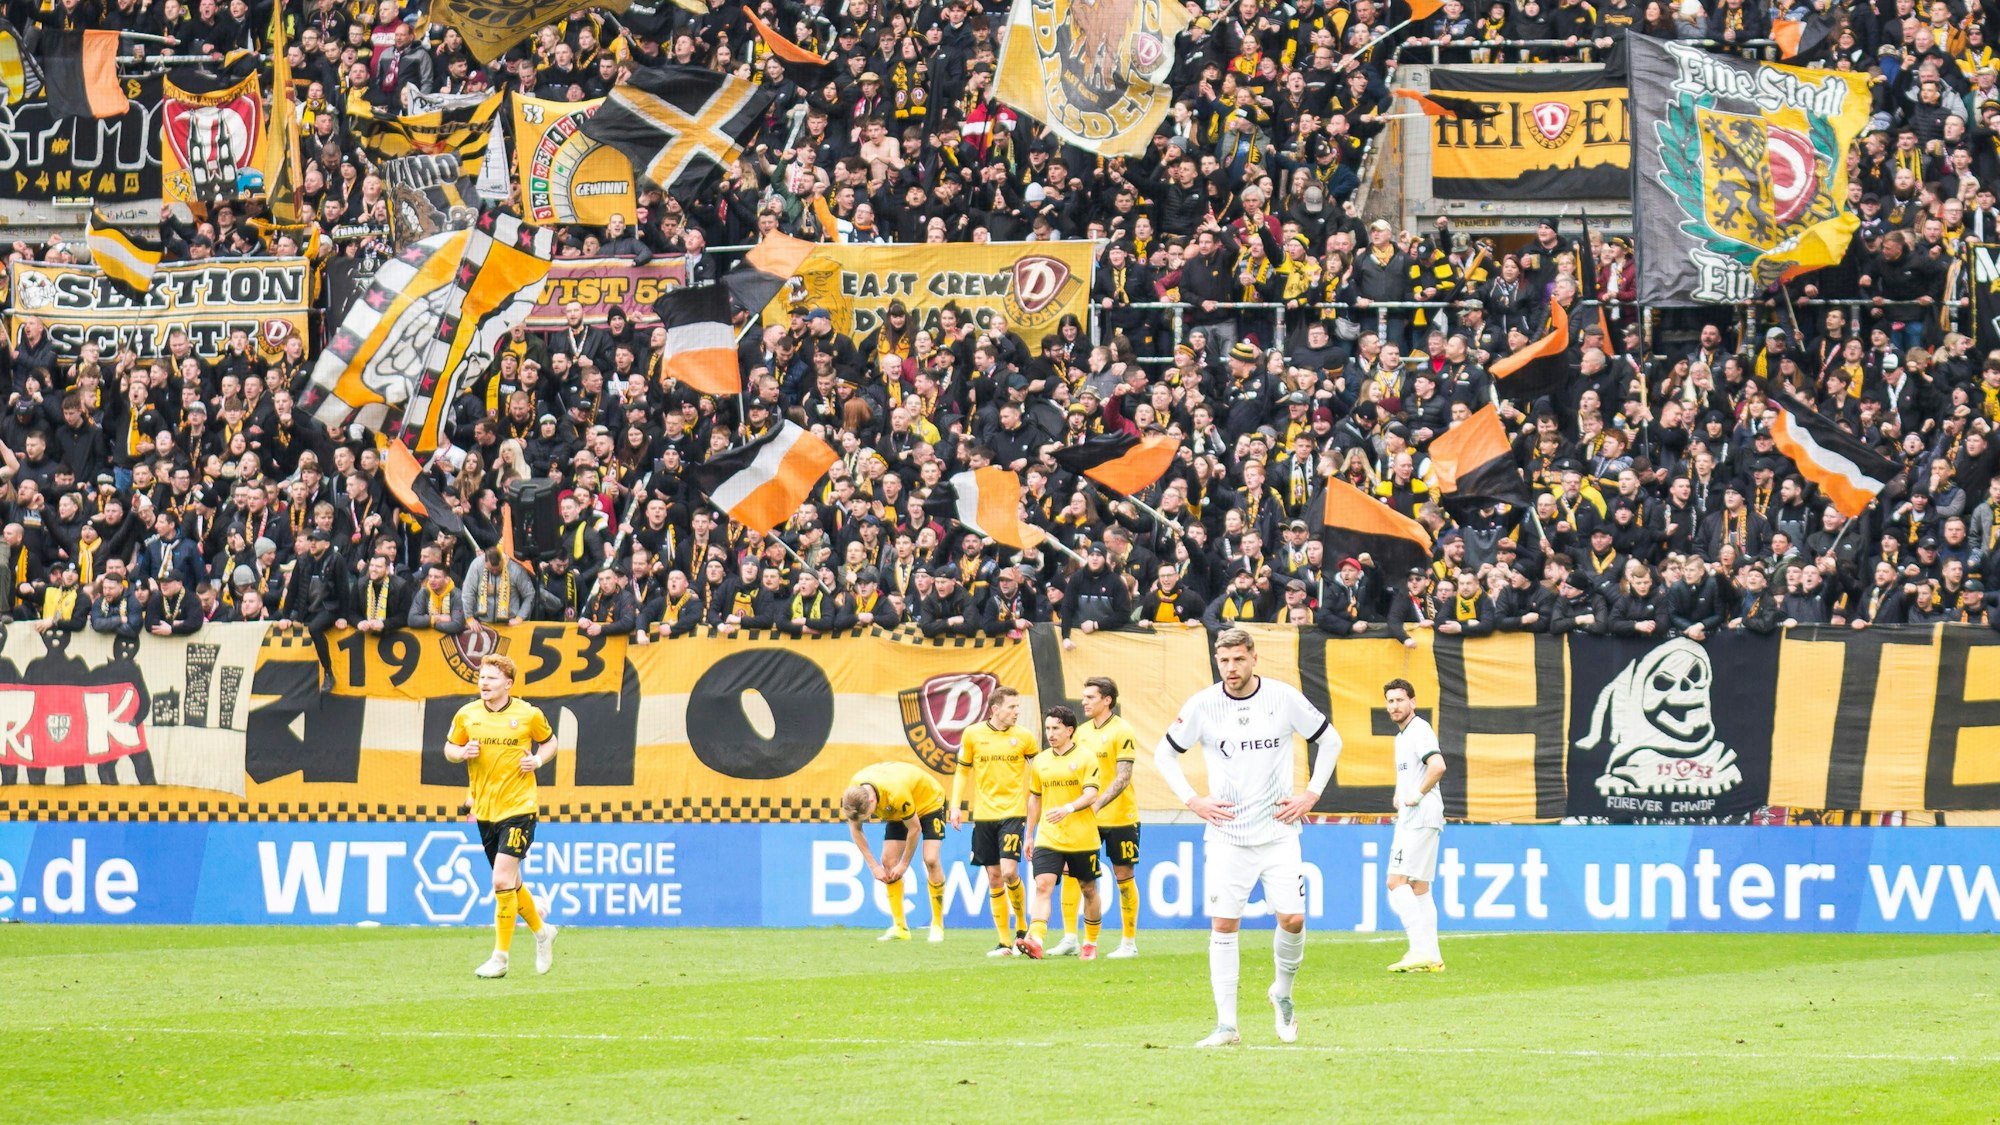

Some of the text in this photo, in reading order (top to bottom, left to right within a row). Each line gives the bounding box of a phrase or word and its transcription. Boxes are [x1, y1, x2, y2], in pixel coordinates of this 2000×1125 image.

[1664, 41, 1848, 117] Eine Stadt
[522, 103, 546, 125] 53
[539, 150, 552, 166] 53
[536, 165, 550, 178] 32
[575, 180, 630, 197] GEWINNT
[841, 271, 1014, 298] EAST CREW
[338, 632, 422, 688] 19
[525, 627, 607, 687] 53
[1240, 737, 1280, 751] FIEGE
[1606, 795, 1717, 813] FOREVER CHWDP
[932, 817, 942, 834] 9
[506, 826, 522, 847] 18
[1003, 833, 1018, 852] 27
[524, 841, 676, 876] ENERGIE
[1120, 841, 1134, 859] 13
[1089, 855, 1098, 872] 7
[257, 841, 407, 914] WT
[1354, 841, 1548, 932] jtzt
